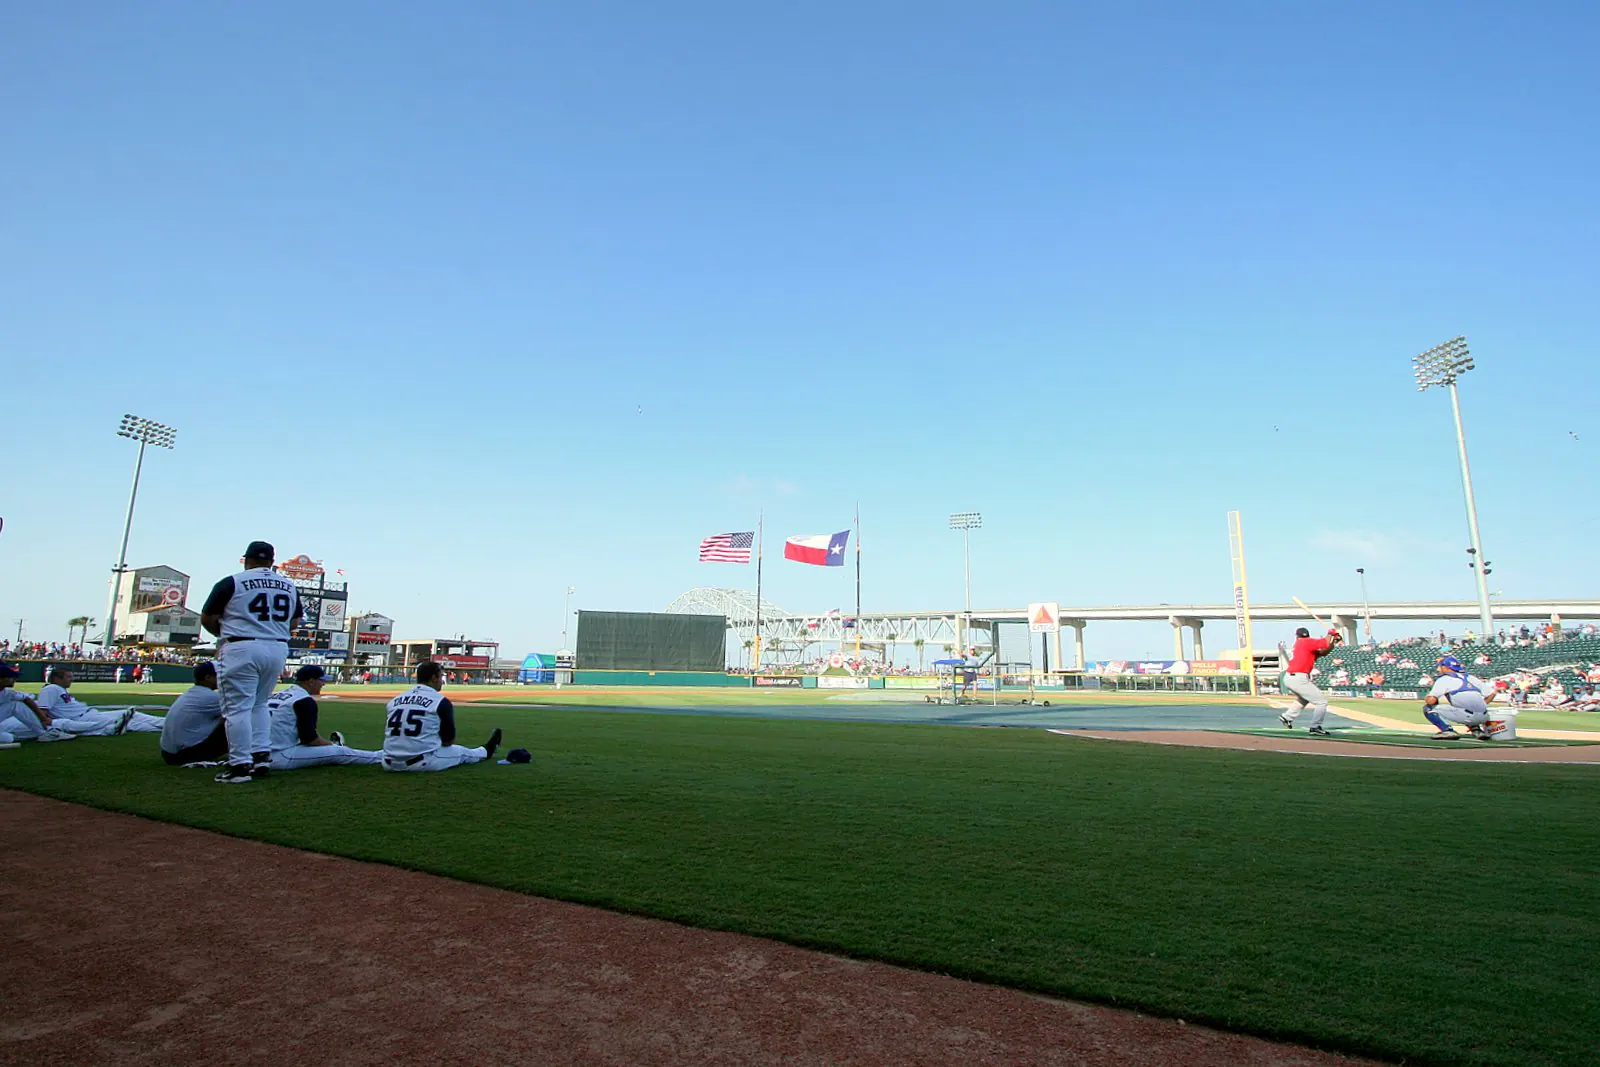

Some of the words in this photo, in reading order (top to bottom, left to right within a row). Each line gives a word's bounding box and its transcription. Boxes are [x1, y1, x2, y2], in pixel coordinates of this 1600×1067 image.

[242, 578, 293, 593] FATHEREE
[248, 593, 290, 622] 49
[393, 696, 434, 708] TAMARGO
[388, 709, 426, 736] 45
